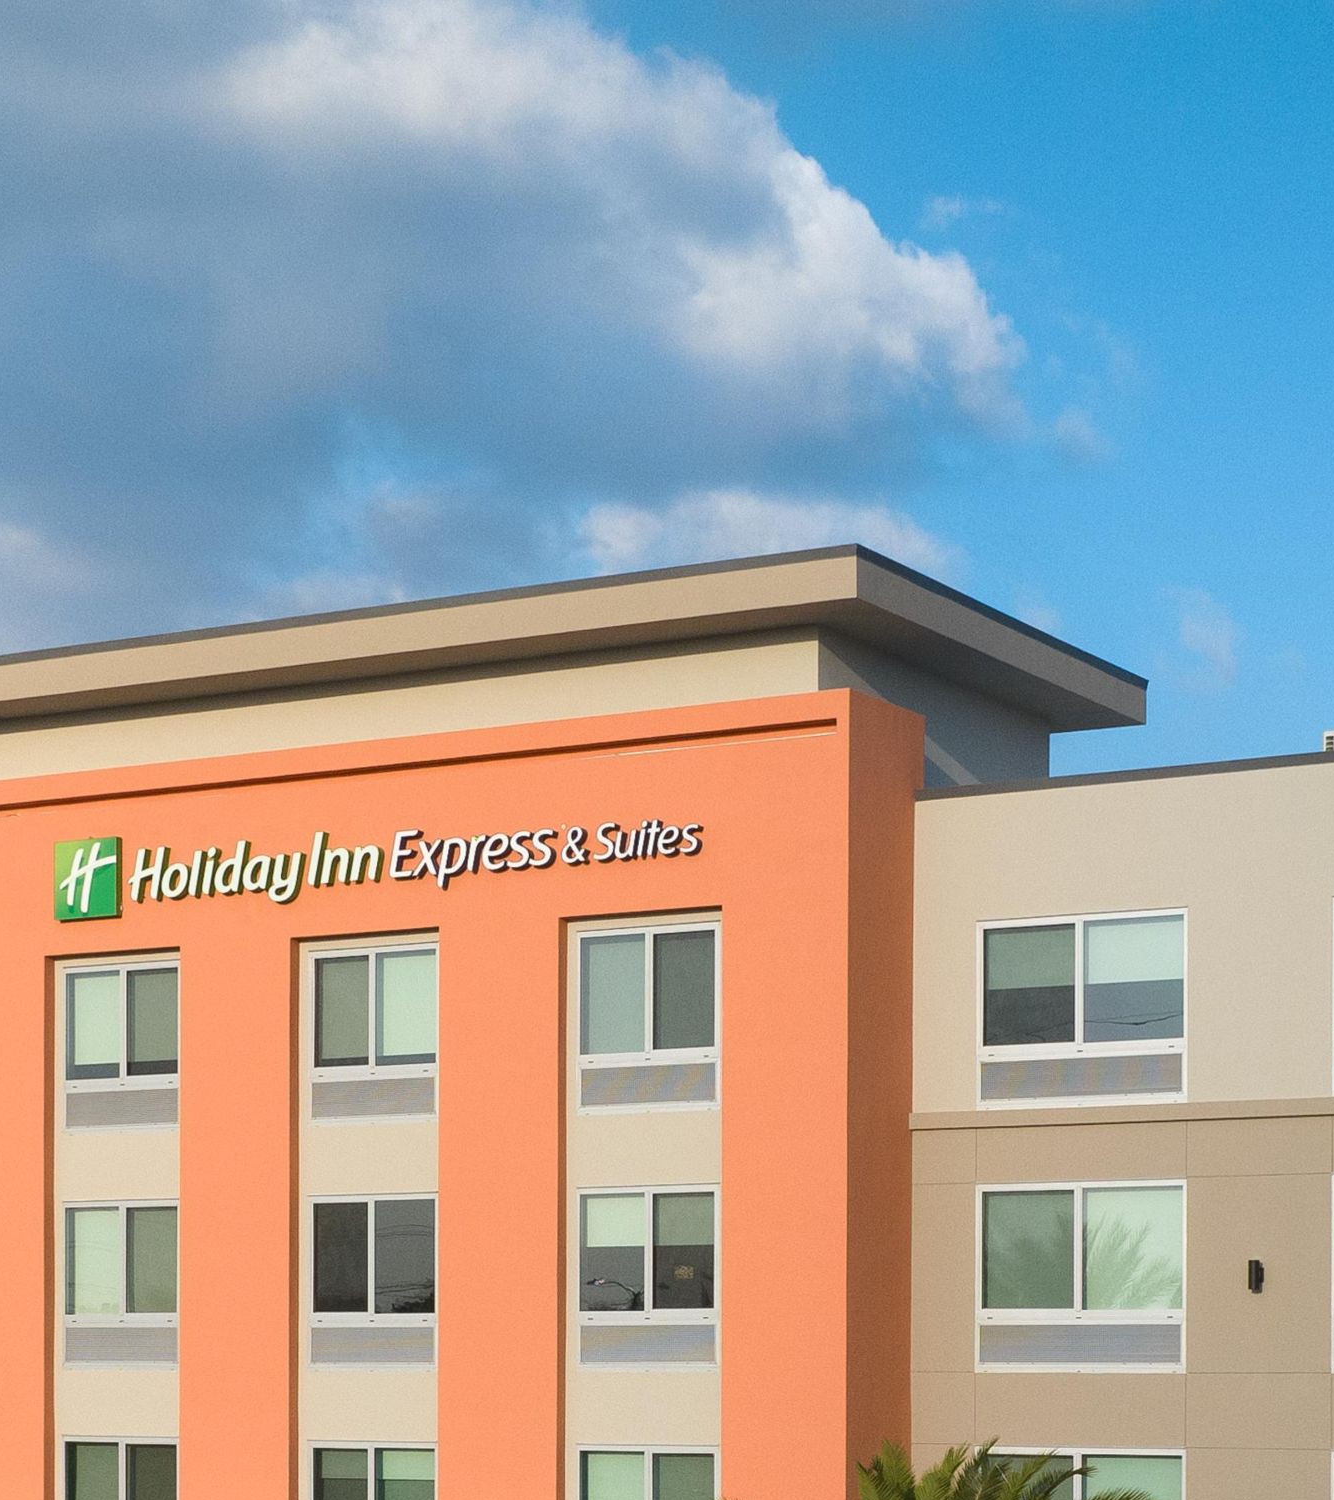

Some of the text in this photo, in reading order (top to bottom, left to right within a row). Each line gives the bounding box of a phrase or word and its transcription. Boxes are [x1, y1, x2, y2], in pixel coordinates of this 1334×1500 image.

[128, 819, 703, 904] Holiday Inn Express & Suites
